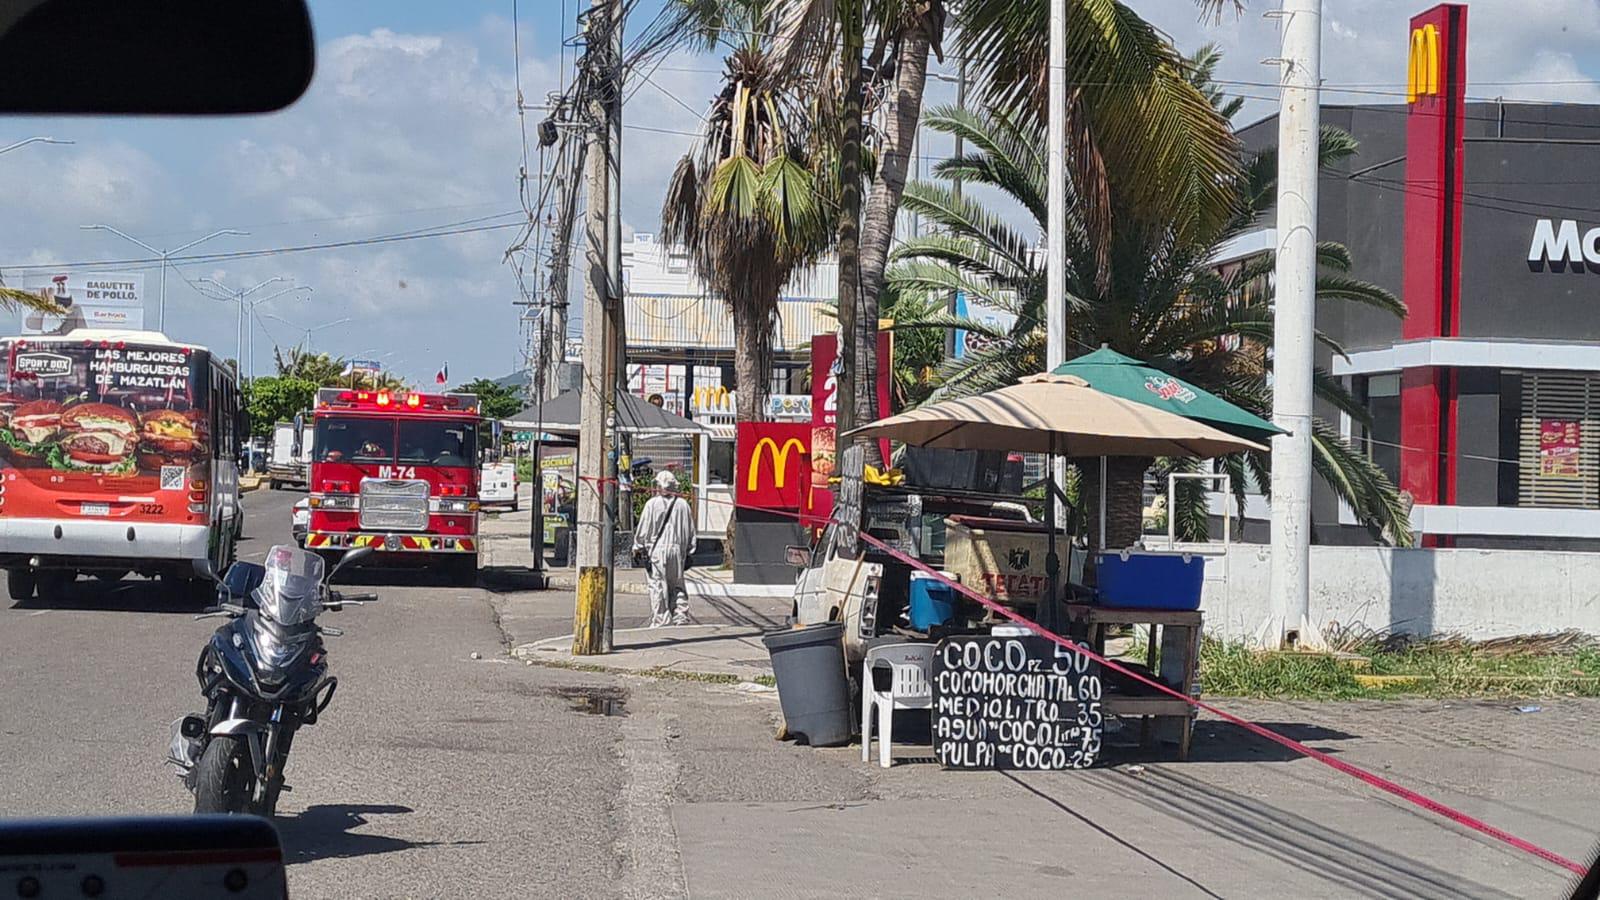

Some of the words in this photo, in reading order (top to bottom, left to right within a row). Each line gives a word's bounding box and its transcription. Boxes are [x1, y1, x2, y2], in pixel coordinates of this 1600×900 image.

[87, 281, 135, 290] BAGUETTE
[87, 290, 101, 299] DE
[103, 290, 138, 300] POLLO.
[20, 357, 48, 368] SPORT
[95, 349, 120, 359] LAS
[127, 351, 186, 363] MEJORES
[90, 361, 190, 377] HAMBURGUESAS
[95, 374, 114, 385] DE
[120, 375, 186, 389] MAZATLÁN
[379, 465, 415, 479] M-74
[139, 504, 164, 515] 3222
[943, 640, 1026, 673] COCO
[1052, 640, 1090, 675] 50
[1078, 675, 1101, 701] 60
[1077, 702, 1102, 727] 35
[1080, 727, 1103, 753] 75
[941, 741, 996, 767] PULPA
[1012, 743, 1066, 770] COCO
[1072, 750, 1094, 769] 25
